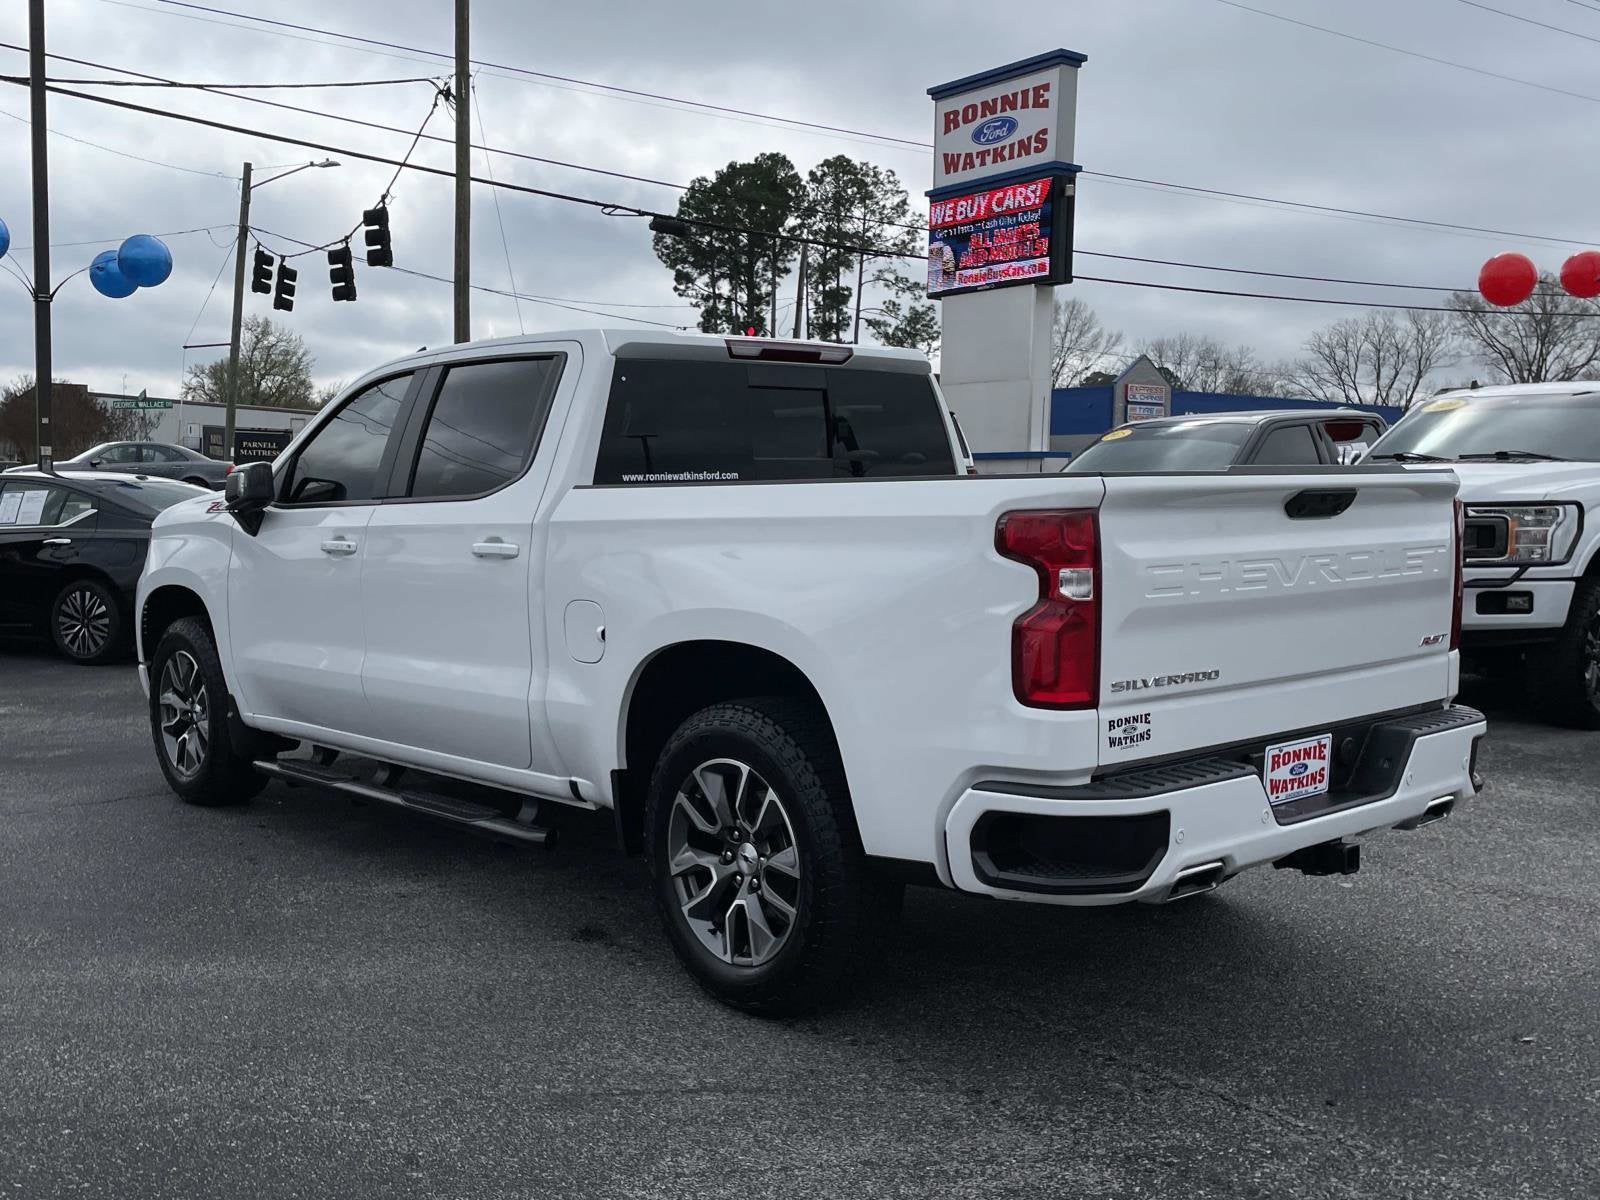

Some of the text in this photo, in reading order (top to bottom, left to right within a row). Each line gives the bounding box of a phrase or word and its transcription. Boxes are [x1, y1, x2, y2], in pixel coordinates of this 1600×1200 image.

[943, 82, 1051, 136] RONNIE
[980, 120, 1009, 142] Ford
[942, 127, 1049, 176] WATKINS
[931, 183, 1041, 225] WE BUY CARS!
[1128, 385, 1164, 395] EXPRESS
[242, 441, 278, 449] PARNELL
[622, 470, 739, 482] www.ronniewatkinsford.com
[1145, 544, 1448, 598] CHEVROLET
[1418, 633, 1448, 648] RST
[1110, 669, 1220, 693] SILVERADO
[1108, 712, 1151, 732] RONNIE
[1108, 728, 1151, 748] WATKINS
[1270, 743, 1327, 773] RONNIE
[1269, 766, 1326, 796] WATKINS
